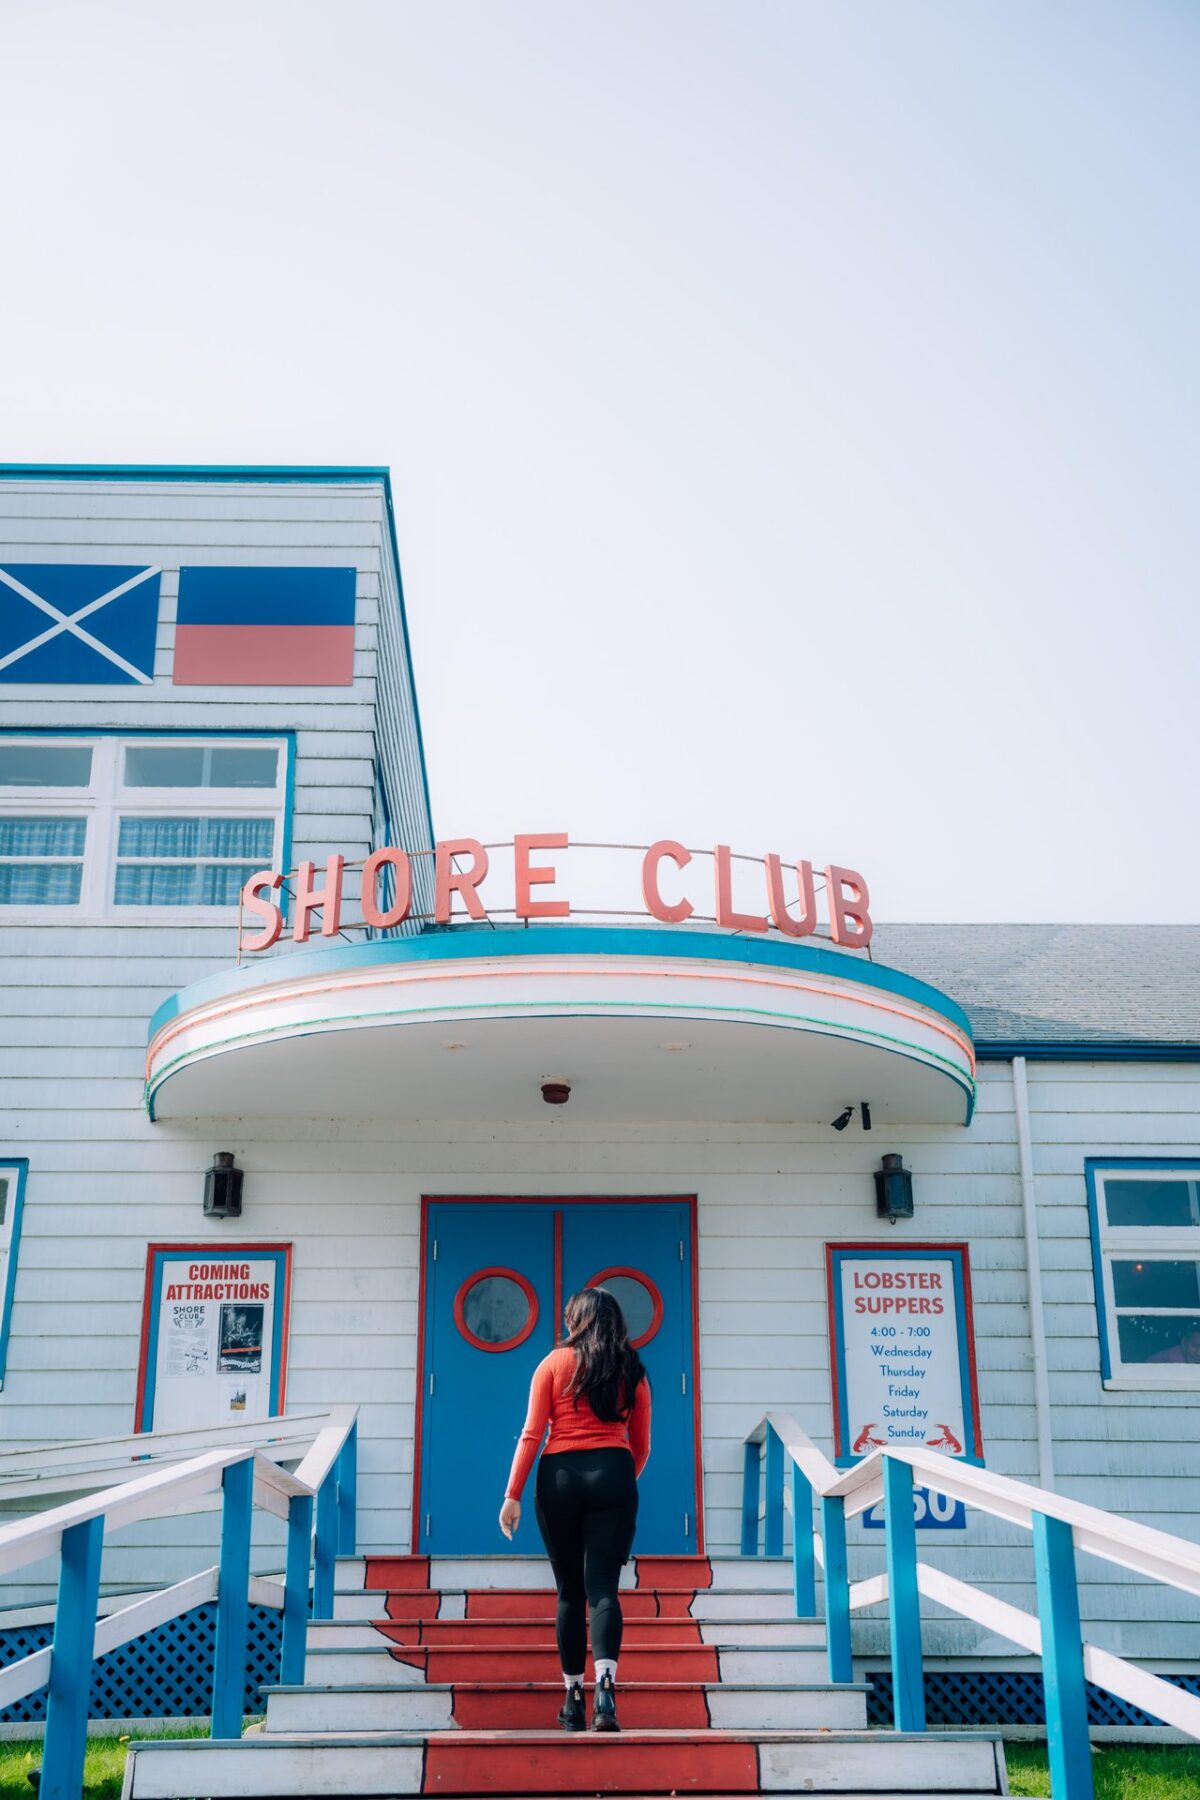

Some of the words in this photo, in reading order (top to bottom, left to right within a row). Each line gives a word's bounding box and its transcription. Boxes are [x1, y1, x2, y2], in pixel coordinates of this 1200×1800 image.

[242, 832, 570, 951] SHORE
[641, 840, 873, 949] CLUB
[188, 1264, 250, 1281] COMING
[854, 1272, 943, 1289] LOBSTER
[166, 1283, 270, 1300] ATTRACTIONS
[173, 1305, 206, 1315] SHORE
[854, 1297, 944, 1314] SUPPERS
[870, 1327, 896, 1337] 4:00
[907, 1327, 931, 1337] 7:00
[870, 1345, 933, 1359] Wednesday
[880, 1365, 926, 1379] Thursday
[888, 1385, 920, 1399] Friday
[882, 1405, 929, 1419] Saturday
[887, 1425, 926, 1439] Sunday
[870, 1487, 957, 1522] 50
